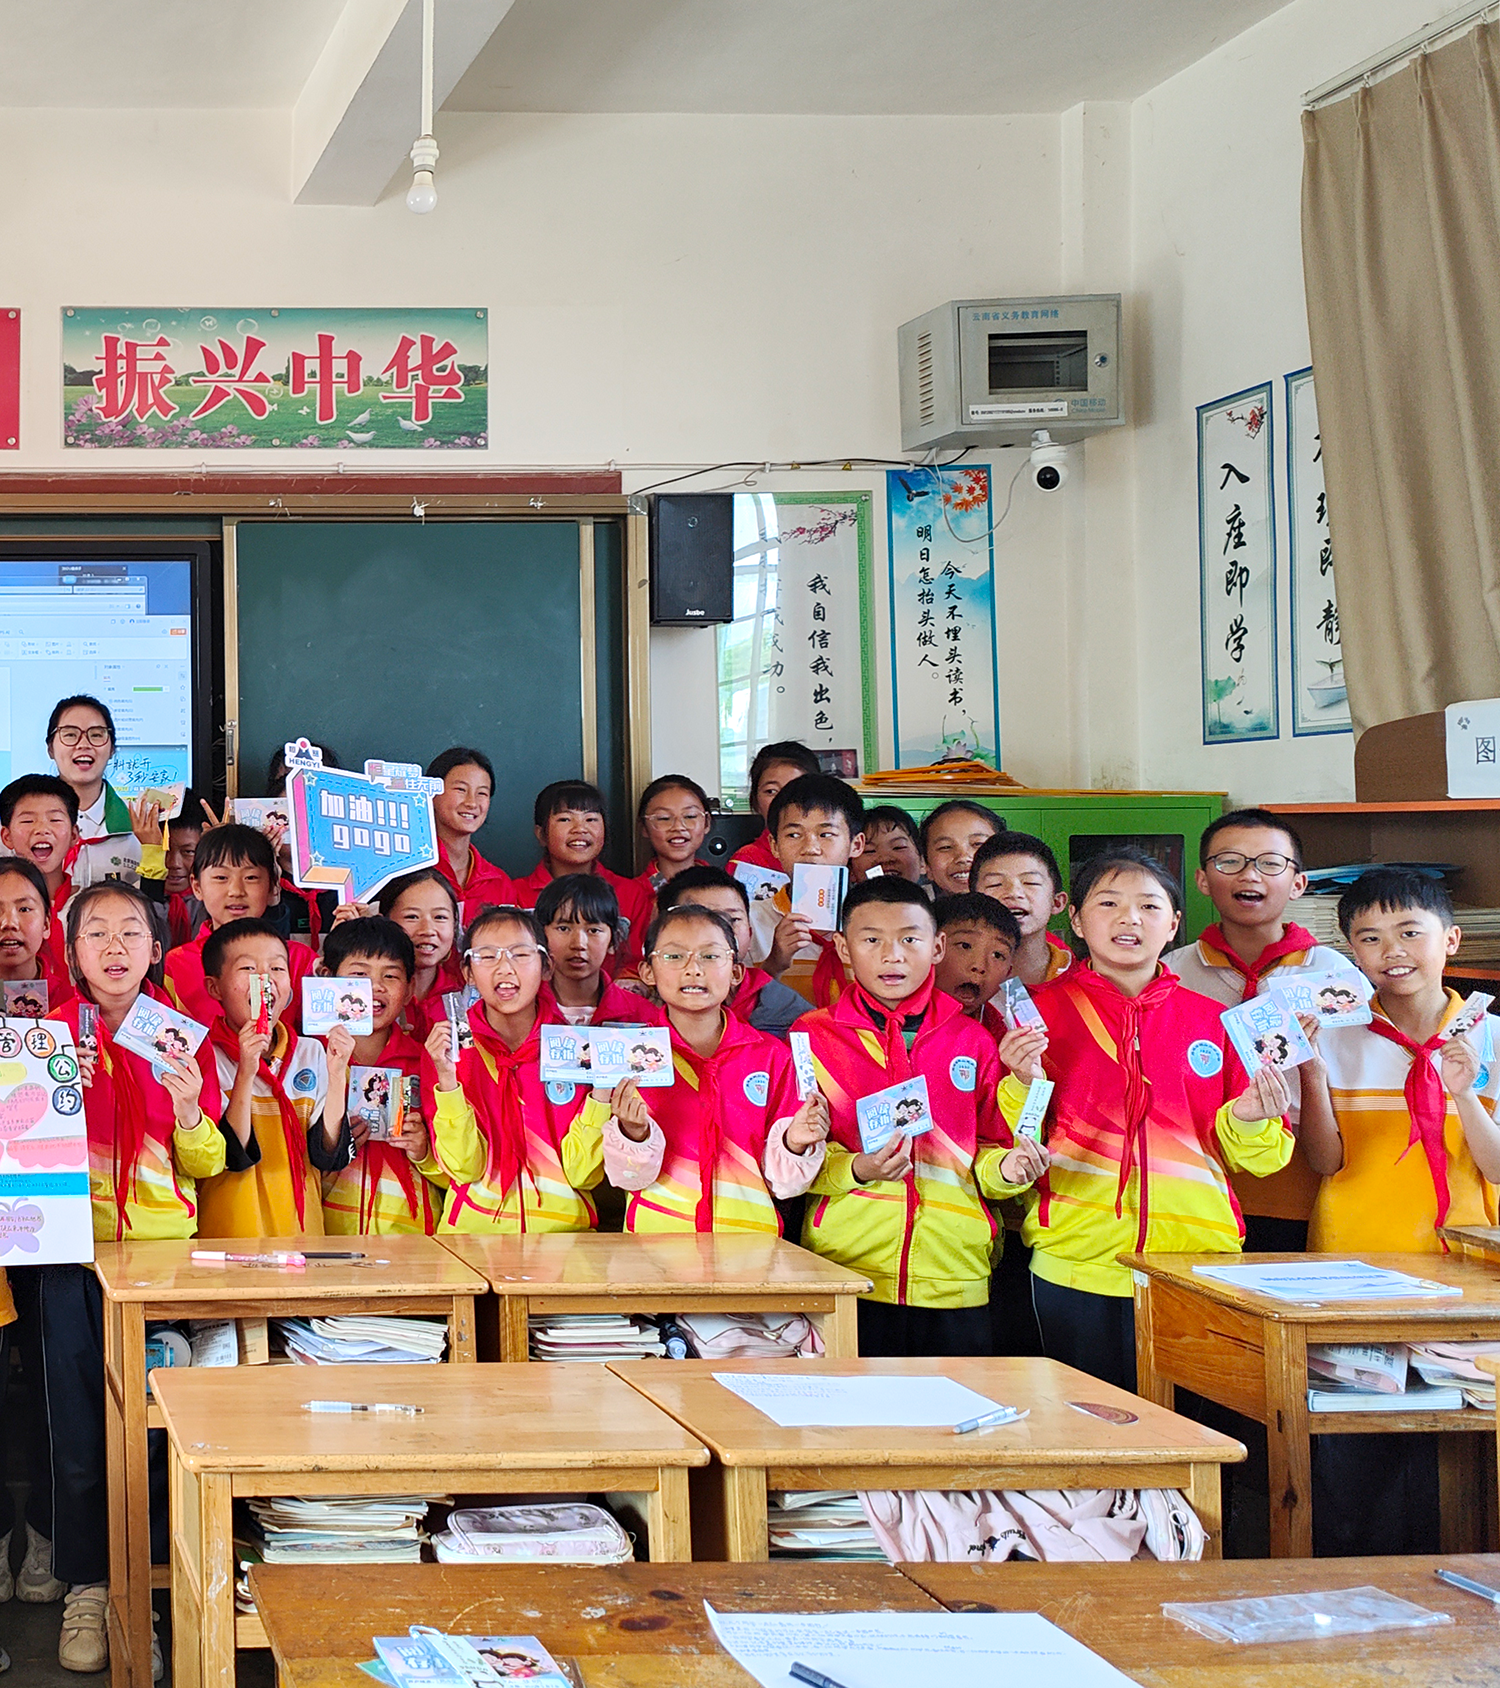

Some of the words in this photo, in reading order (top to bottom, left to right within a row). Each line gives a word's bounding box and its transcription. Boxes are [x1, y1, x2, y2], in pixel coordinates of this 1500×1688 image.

[94, 332, 465, 423] 振兴中华
[1219, 463, 1250, 663] 入座即学
[289, 758, 320, 769] HENGYI
[332, 823, 411, 857] gogo
